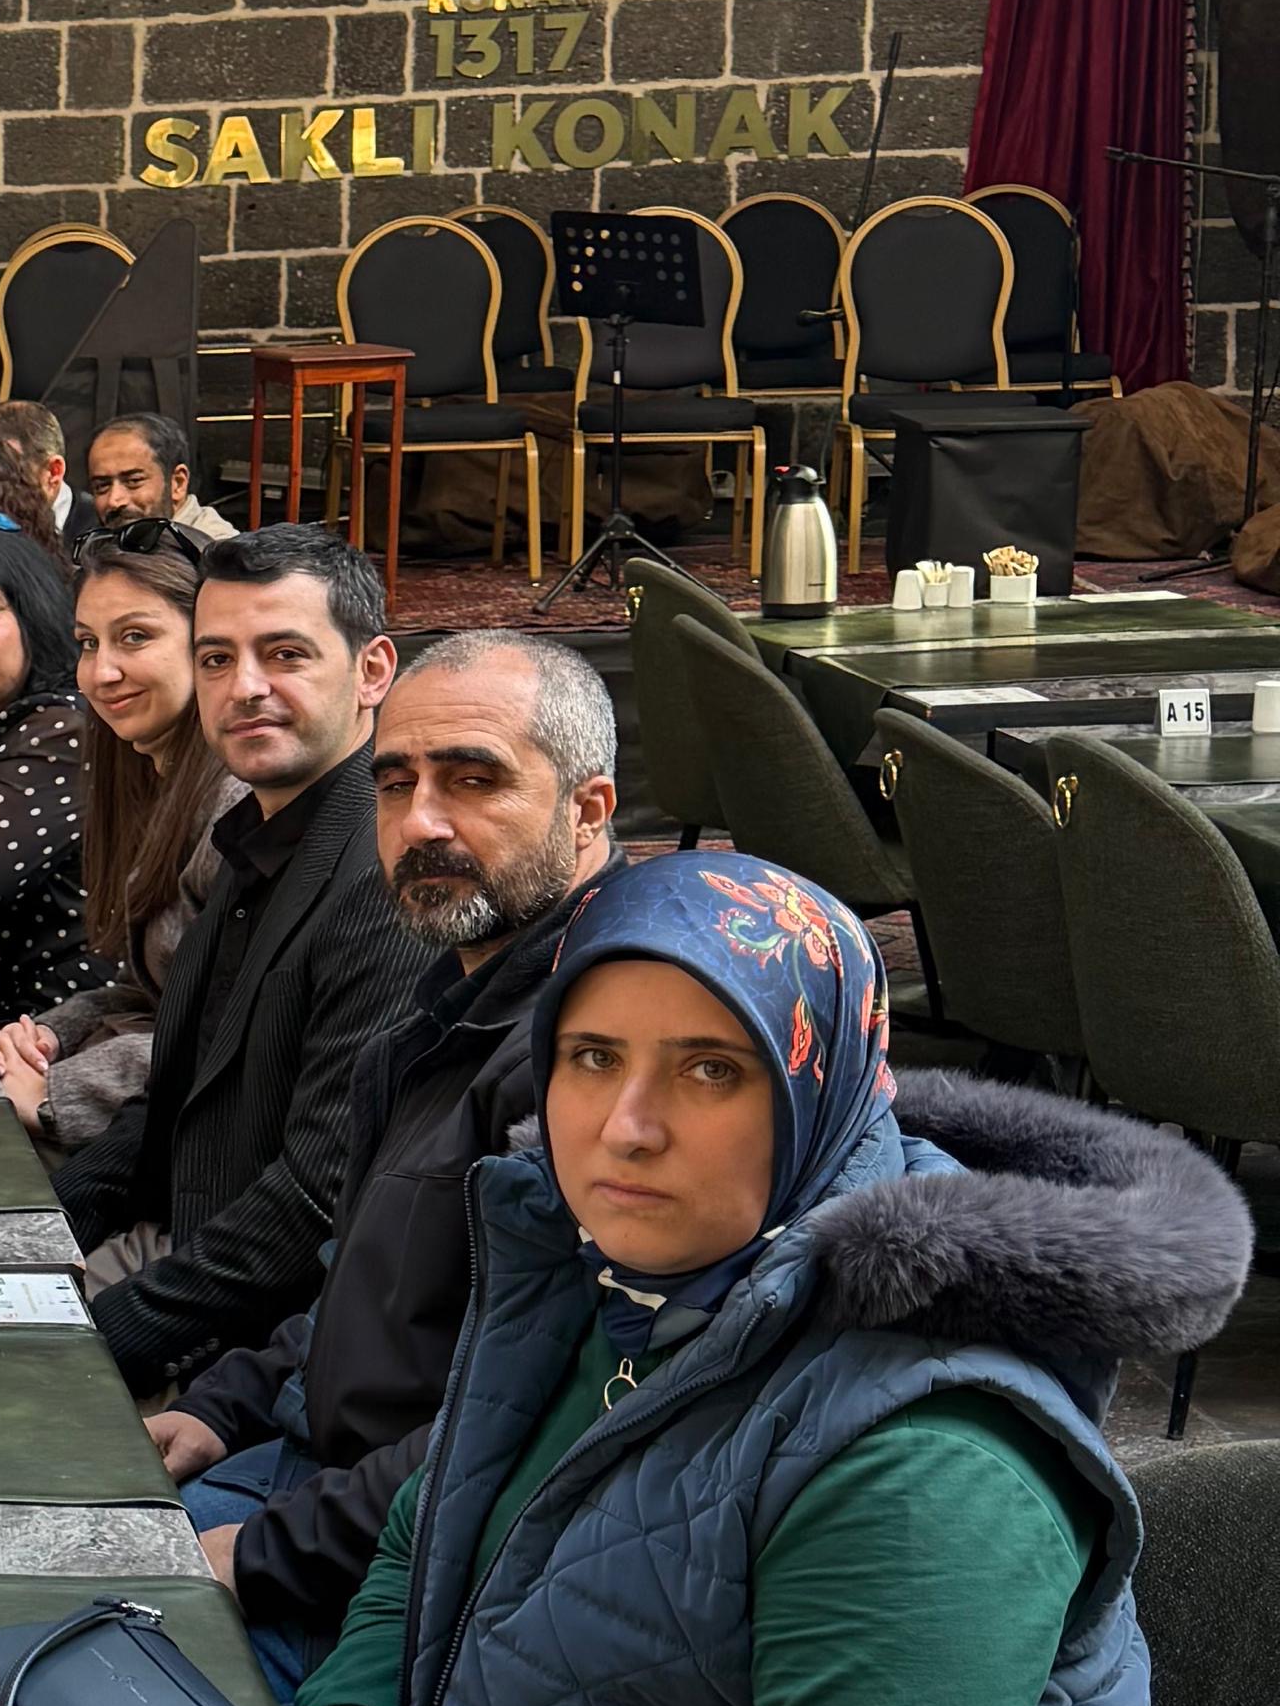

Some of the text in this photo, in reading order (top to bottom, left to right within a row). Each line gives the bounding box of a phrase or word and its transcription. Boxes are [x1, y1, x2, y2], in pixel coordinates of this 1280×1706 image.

[429, 10, 591, 79] 1317
[137, 84, 855, 190] SAKLI KONAK
[1167, 701, 1205, 722] A 15
